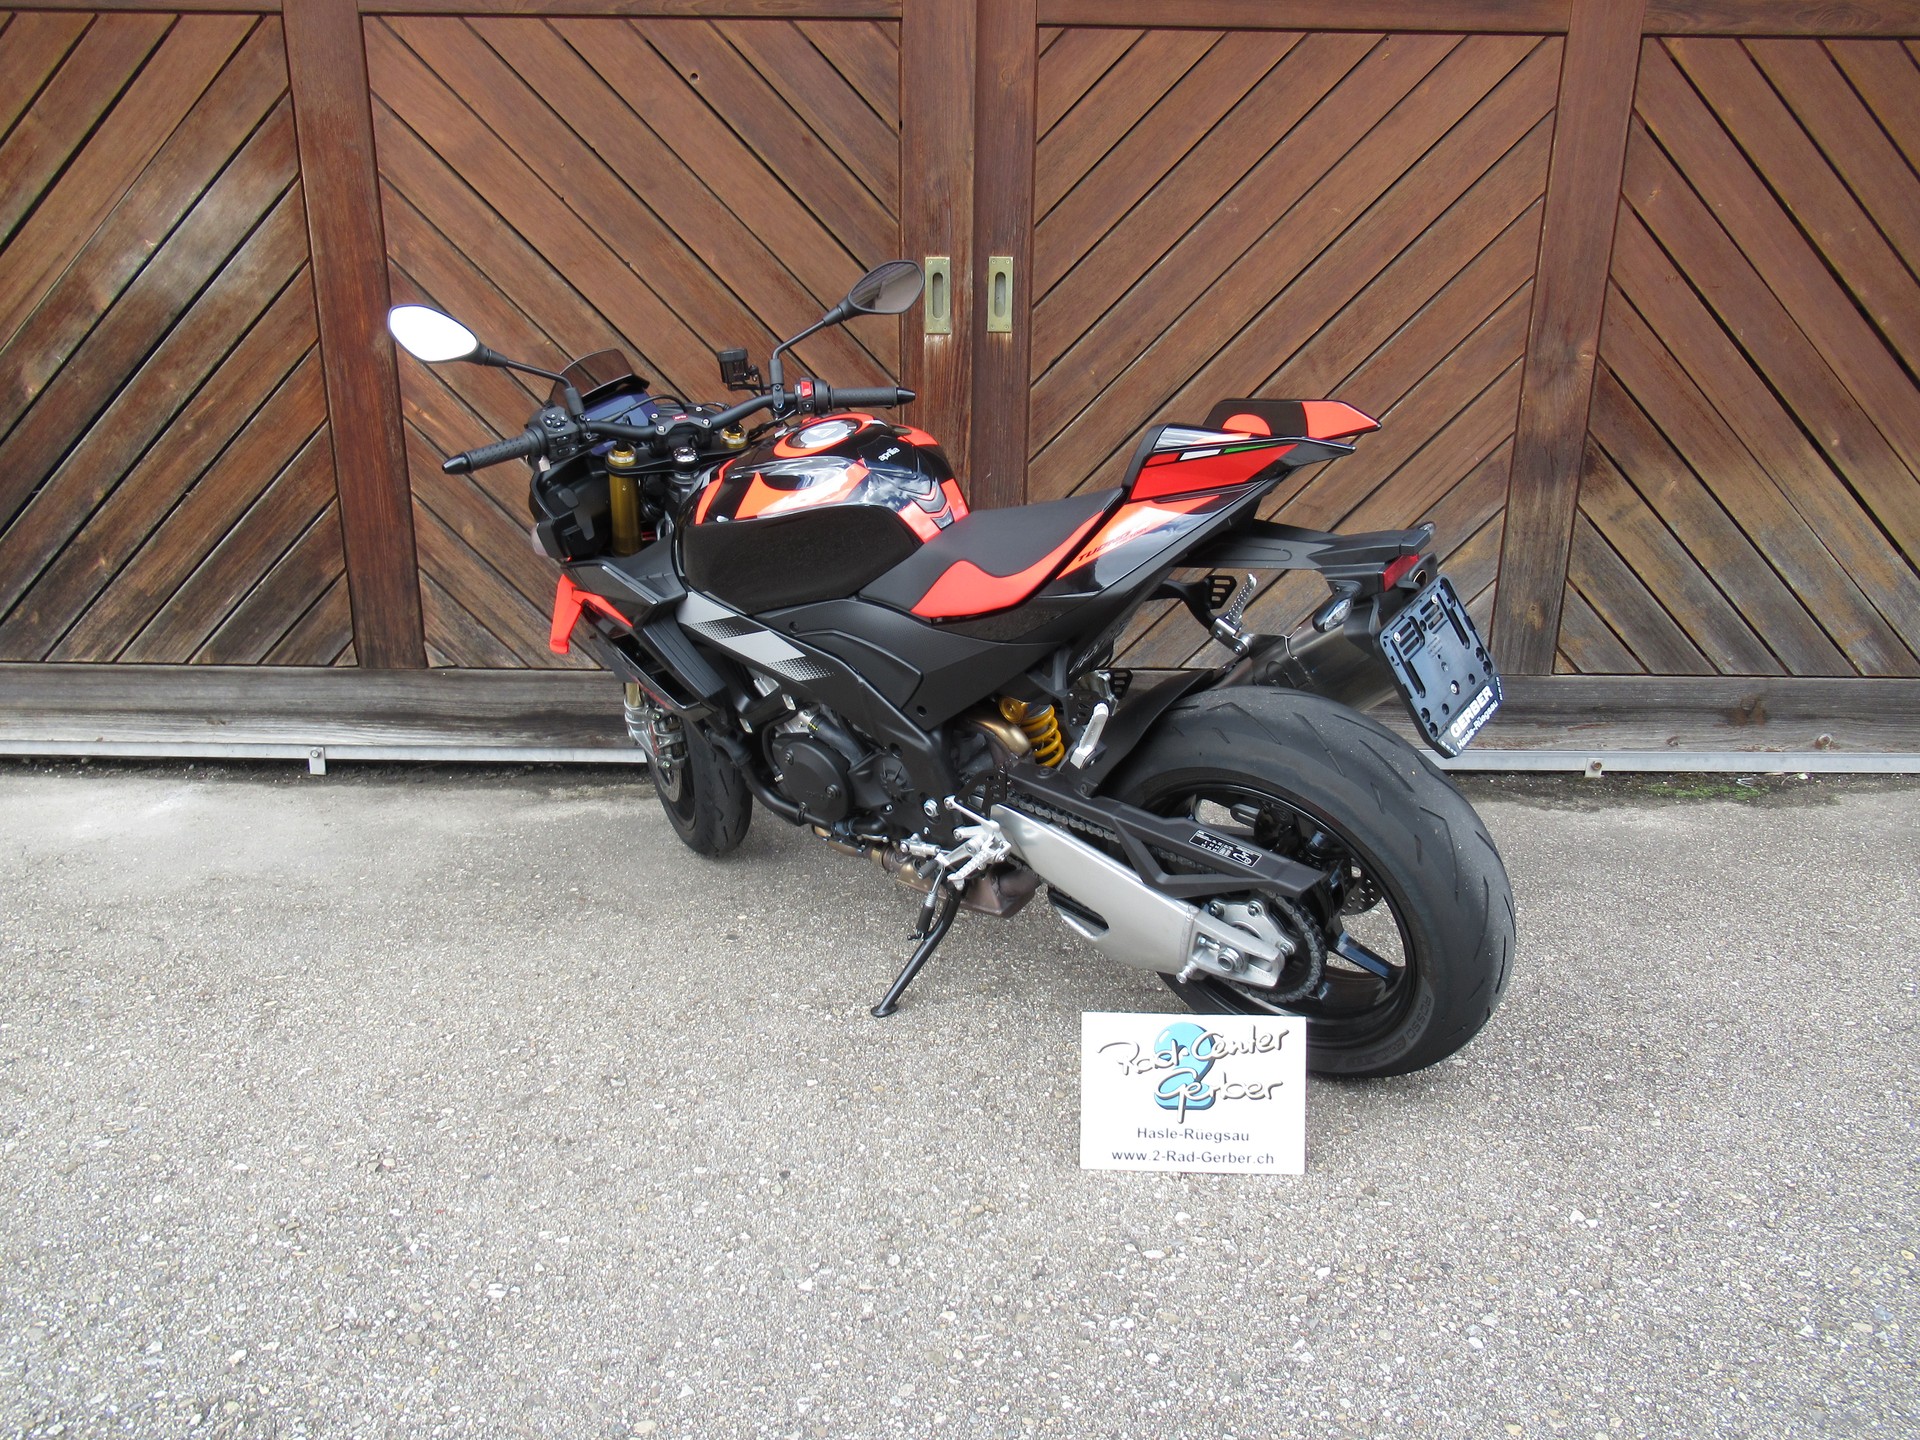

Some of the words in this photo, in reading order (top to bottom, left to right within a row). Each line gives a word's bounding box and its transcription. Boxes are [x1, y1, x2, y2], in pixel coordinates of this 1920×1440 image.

[878, 447, 900, 461] aprilia
[1450, 685, 1493, 738] GERBER
[1154, 1067, 1283, 1124] Gerber
[1136, 1127, 1250, 1144] Hasle-Rüegsau
[1111, 1149, 1275, 1165] www.2-Rad-Gerber.ch
